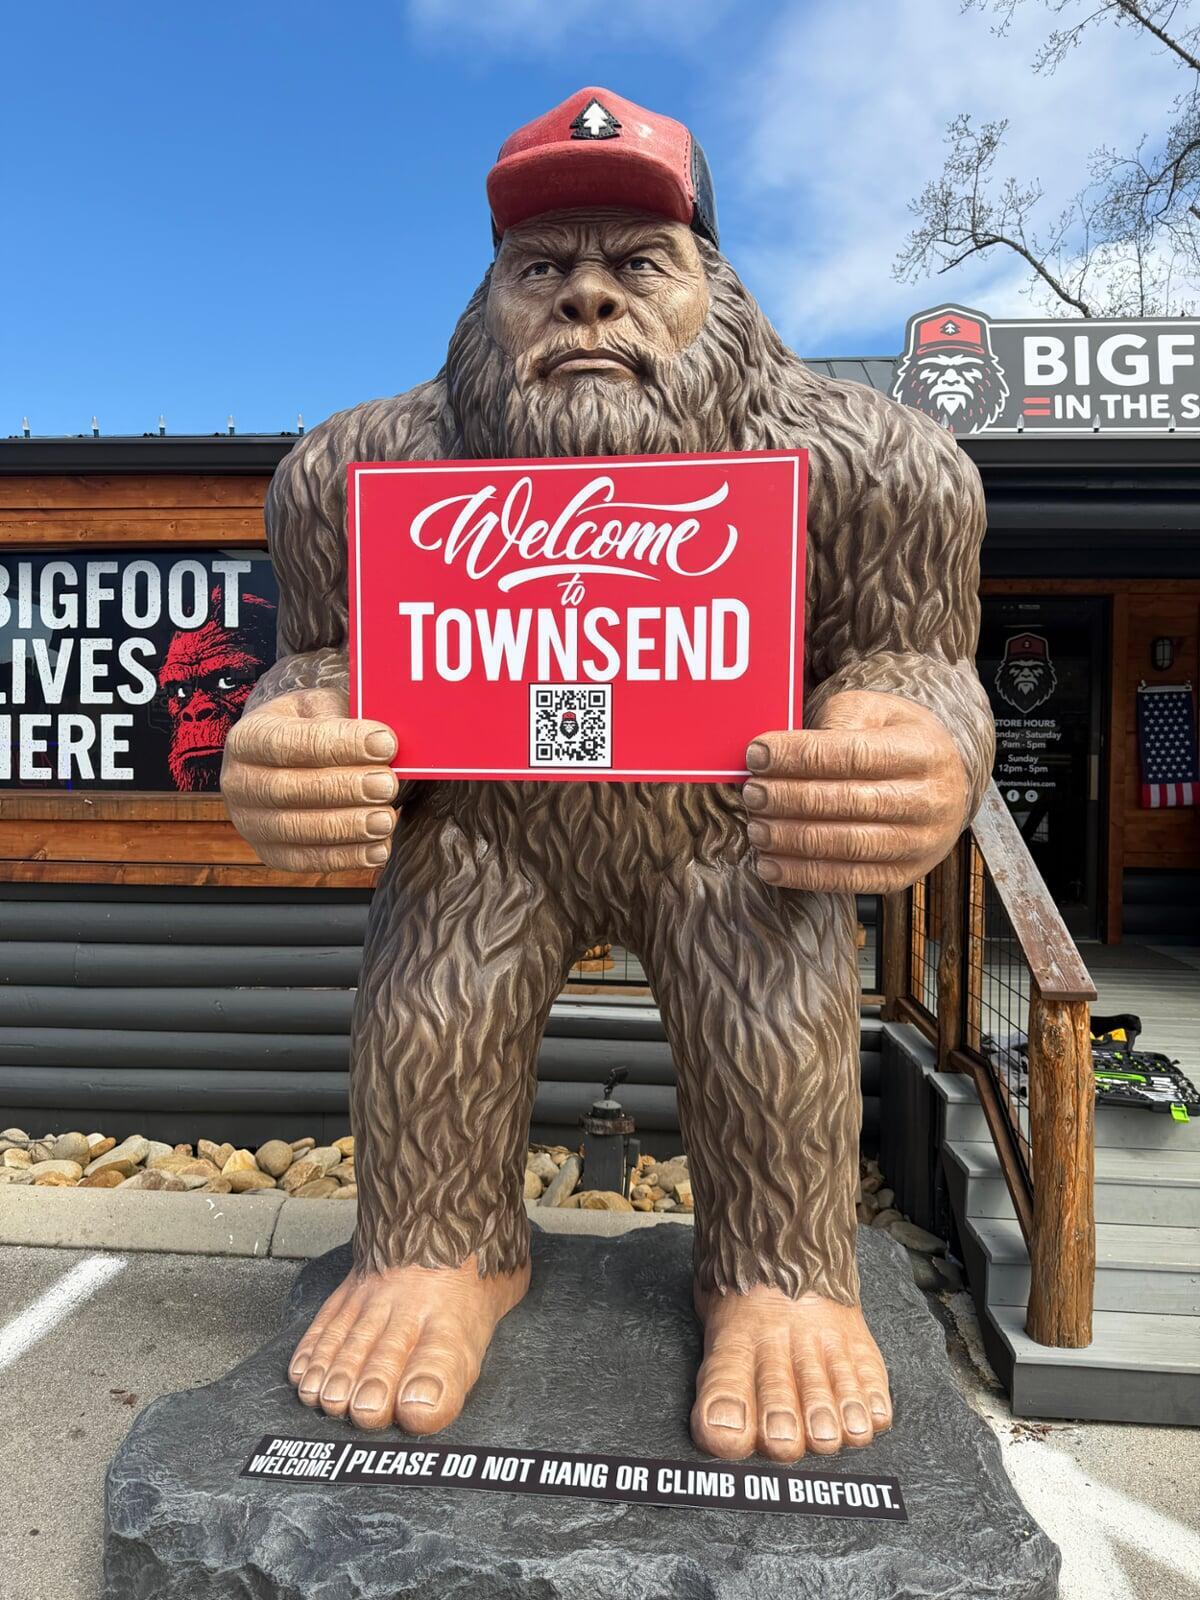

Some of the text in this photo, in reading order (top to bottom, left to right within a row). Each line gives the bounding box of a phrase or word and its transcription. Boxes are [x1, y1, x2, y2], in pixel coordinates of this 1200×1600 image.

[1023, 333, 1195, 387] BIGF
[1054, 394, 1091, 419] IN
[1099, 393, 1171, 419] THE
[409, 476, 738, 580] Welcome
[557, 573, 586, 606] to
[398, 598, 750, 682] TOWNSEND
[0, 637, 157, 705] IVES
[995, 730, 1020, 740] onday
[1025, 730, 1062, 741] Saturday
[1023, 719, 1056, 728] HOURS
[1001, 741, 1020, 749] 9am
[1026, 741, 1046, 750] 5pm
[998, 764, 1023, 774] 12pm
[1028, 764, 1048, 774] 5pm
[1007, 754, 1039, 764] Sunday
[265, 1439, 335, 1459] PHOTOS
[248, 1455, 336, 1478] WELCOME
[345, 1449, 900, 1510] PLEASE DO NOT HANG OR CLIMB ON BIGFOOT.
